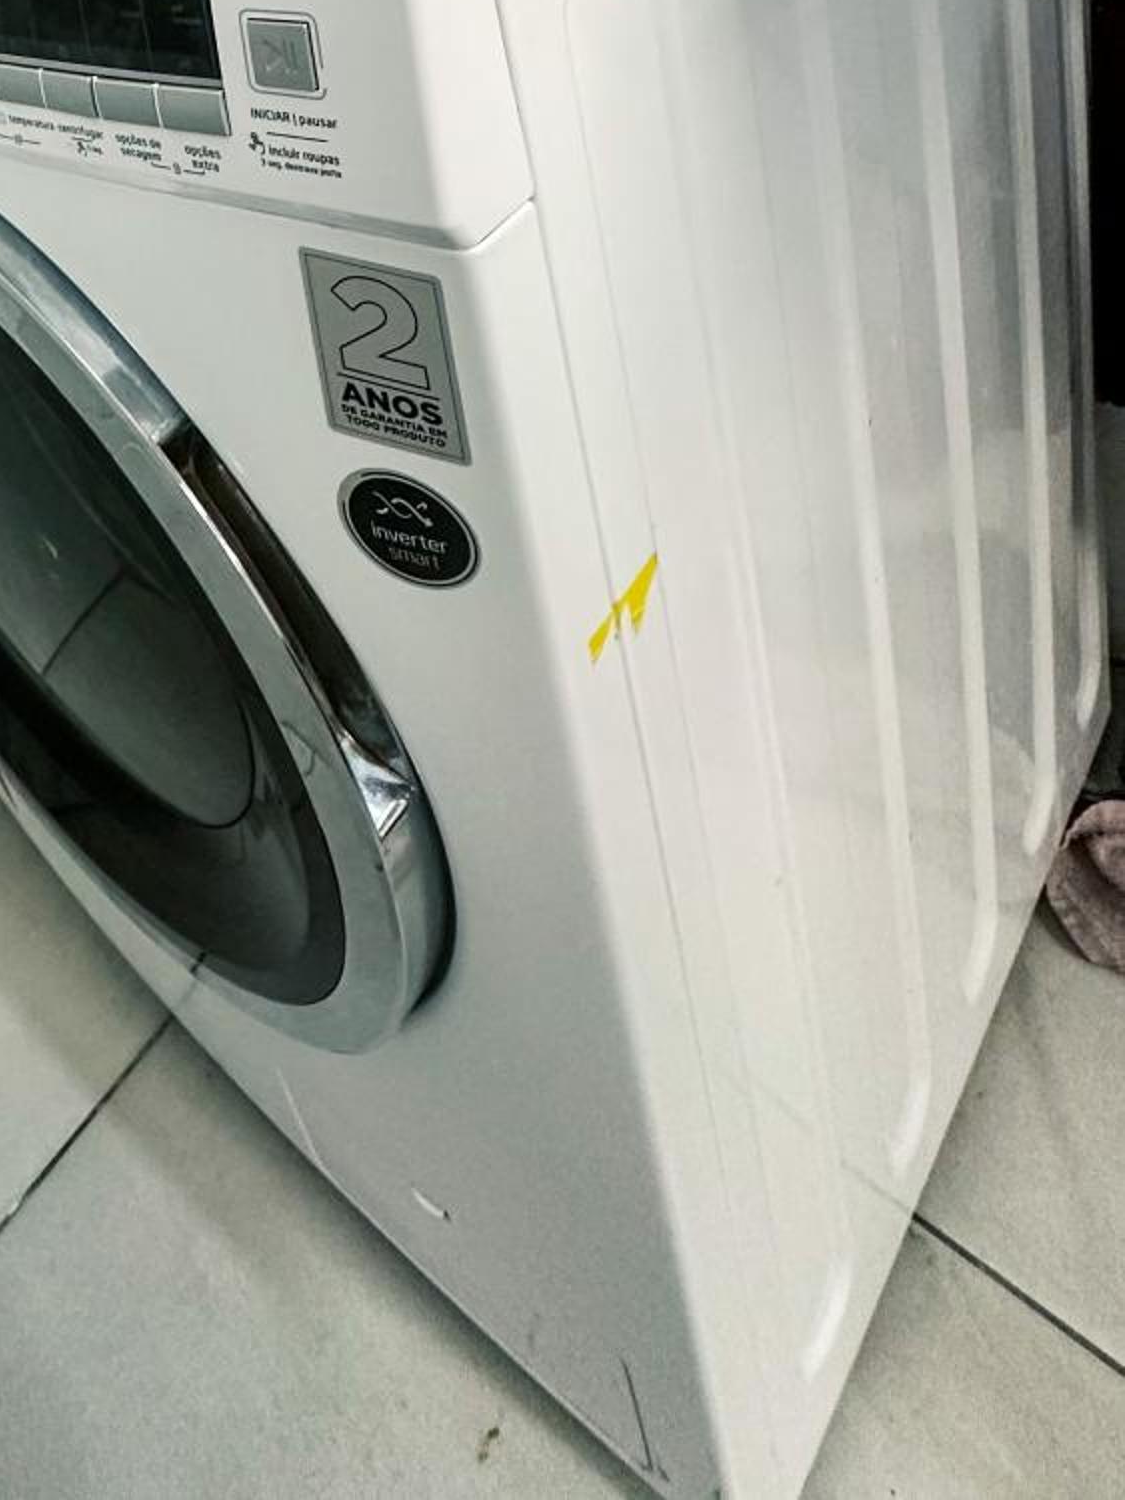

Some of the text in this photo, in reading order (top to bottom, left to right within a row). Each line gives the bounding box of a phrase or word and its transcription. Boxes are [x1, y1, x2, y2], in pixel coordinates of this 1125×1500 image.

[250, 107, 337, 129] INICIAR pausar
[302, 150, 340, 167] roupas
[330, 275, 431, 391] 2
[342, 381, 443, 425] ANOS
[341, 403, 448, 439] DE GARANTIA EM
[346, 414, 446, 448] TODO PRODUTO
[371, 519, 448, 554] inverter
